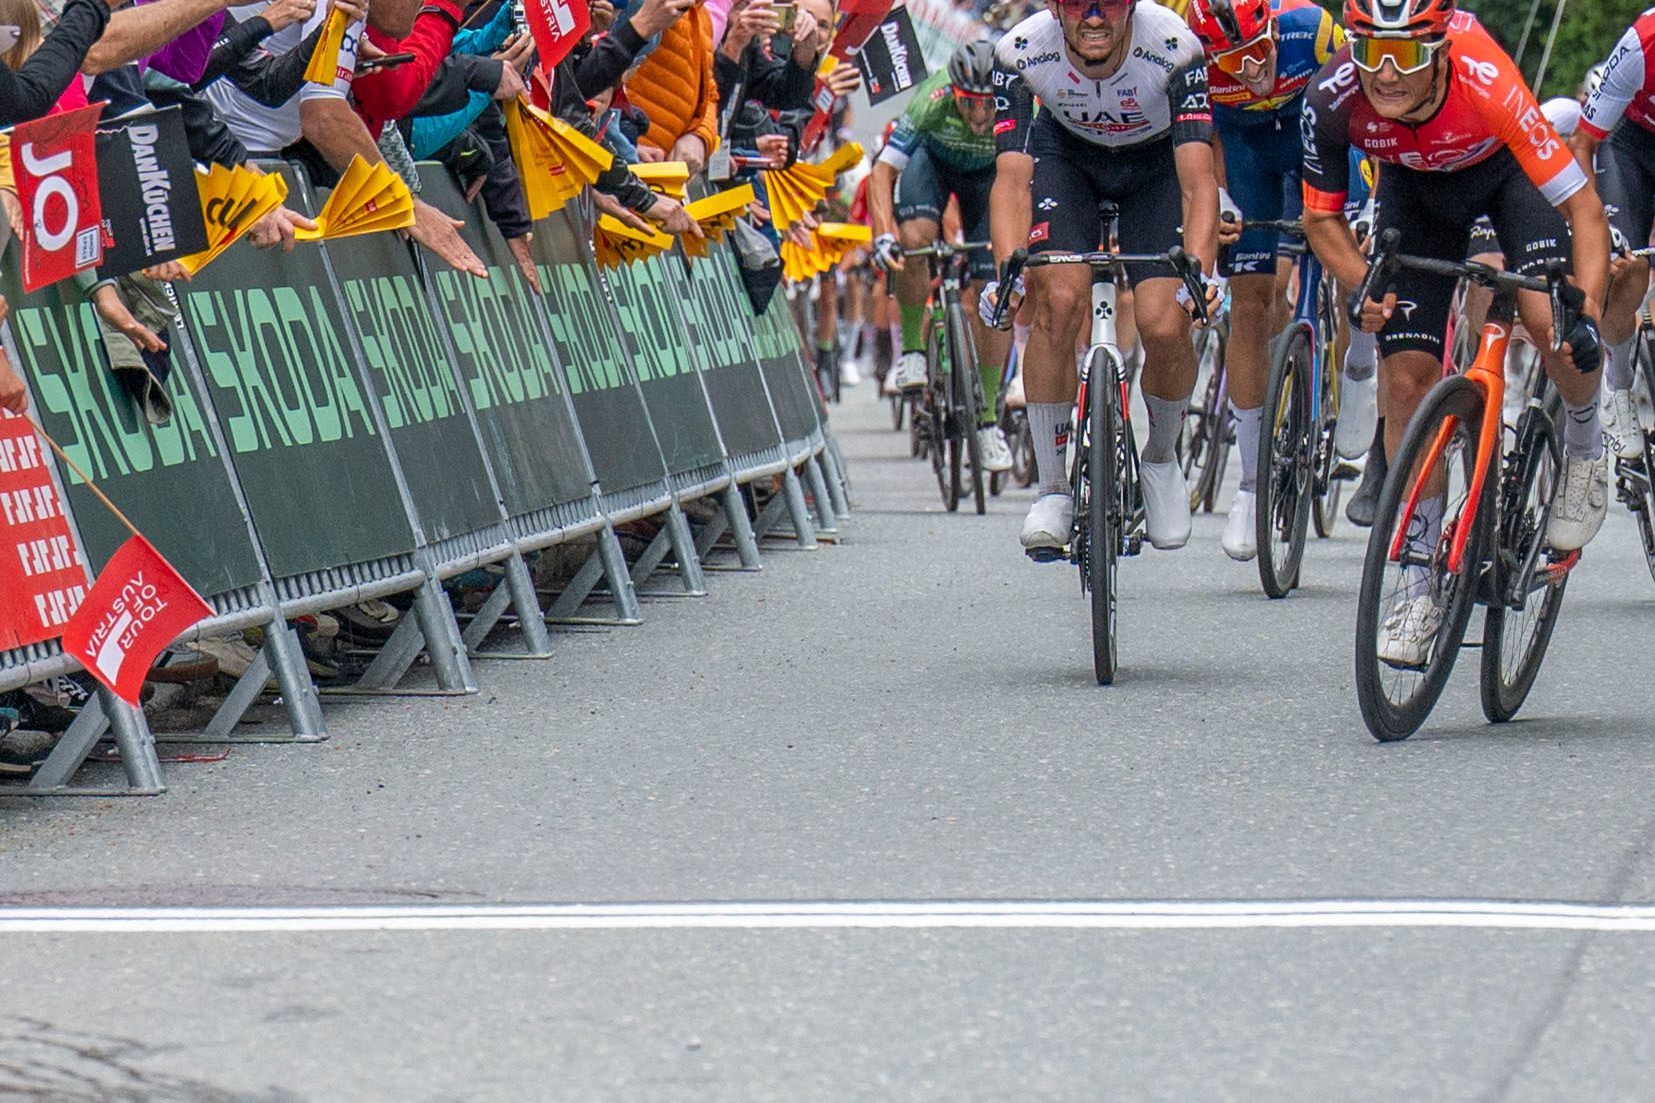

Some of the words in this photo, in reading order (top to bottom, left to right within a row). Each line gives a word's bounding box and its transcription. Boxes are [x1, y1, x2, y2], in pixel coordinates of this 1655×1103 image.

[1279, 30, 1315, 42] TREK
[1027, 49, 1061, 69] Analog
[1142, 49, 1176, 73] Analog
[1062, 110, 1147, 125] UAE
[1503, 84, 1561, 161] INEOS
[1364, 136, 1399, 149] GOBIK
[20, 141, 80, 252] JO
[126, 123, 177, 254] DANKÜCHEN
[1526, 238, 1558, 253] GOBIK
[133, 583, 158, 613] OF
[85, 571, 144, 659] AUSTRIA
[120, 595, 169, 650] TOUR
